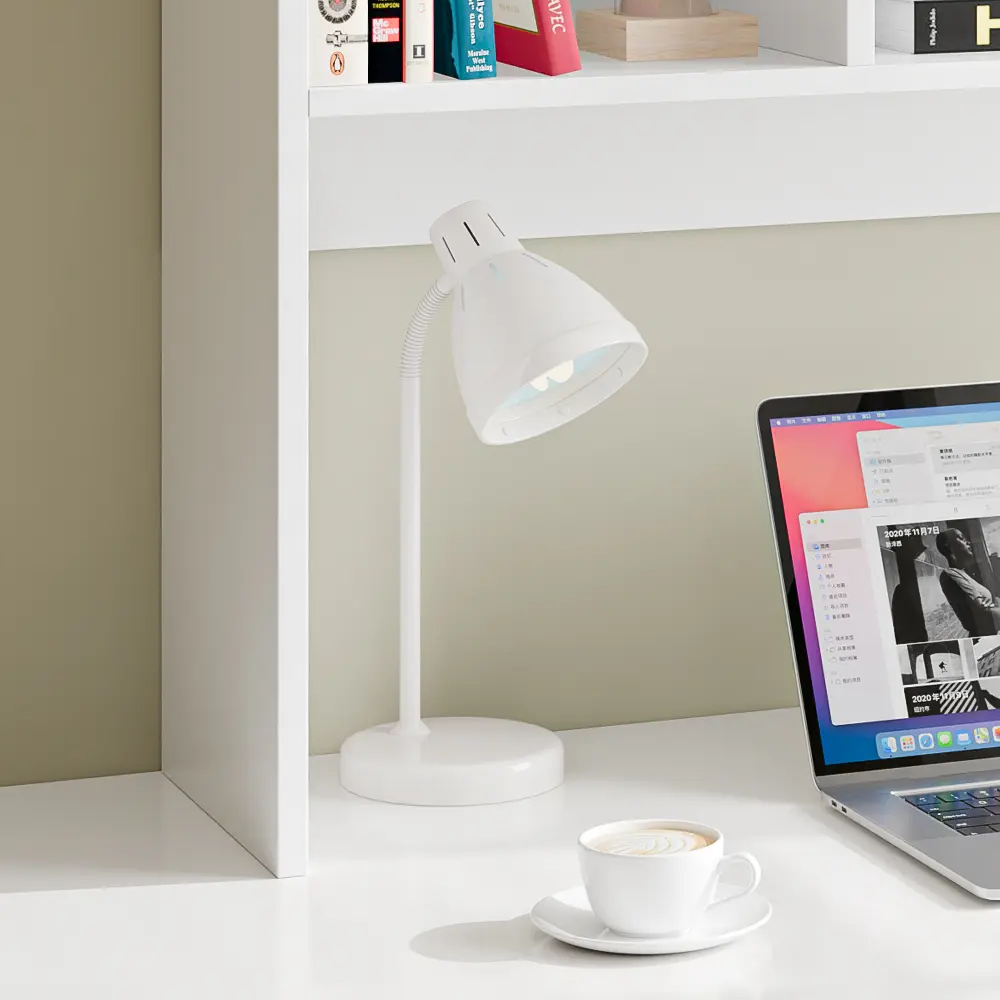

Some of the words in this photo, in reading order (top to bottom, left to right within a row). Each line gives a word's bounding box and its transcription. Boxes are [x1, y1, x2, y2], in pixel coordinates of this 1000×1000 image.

[373, 18, 389, 28] Mc
[373, 27, 400, 35] Graw
[468, 12, 476, 45] Gibson
[373, 34, 389, 43] Hill
[466, 64, 493, 73] Publishing
[884, 526, 940, 539] 2020年11月7日
